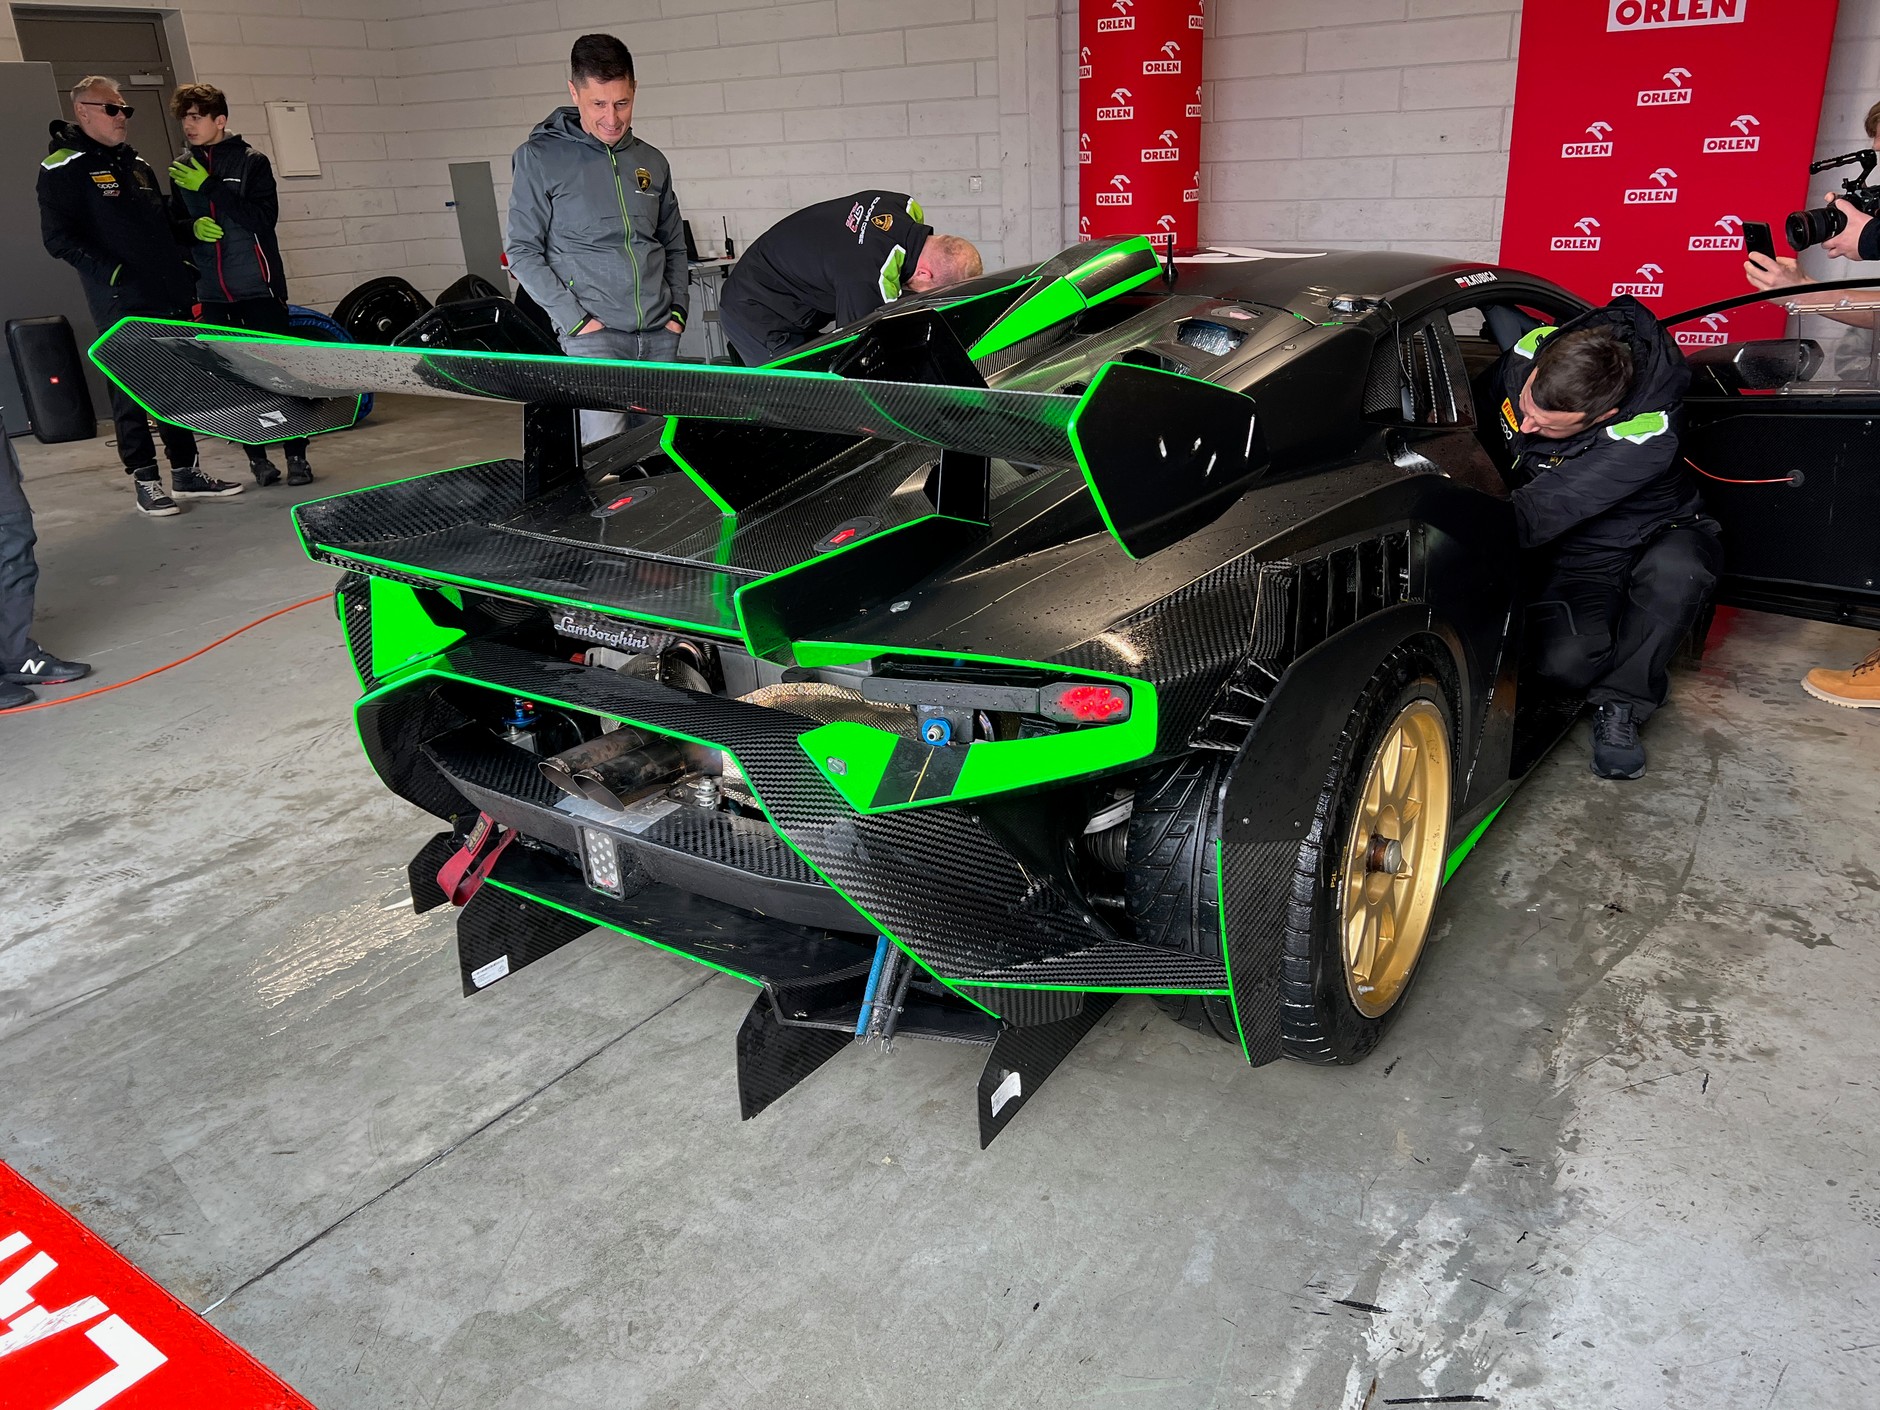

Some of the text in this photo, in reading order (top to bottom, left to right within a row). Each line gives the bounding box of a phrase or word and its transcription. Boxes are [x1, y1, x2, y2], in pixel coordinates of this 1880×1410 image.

[1615, 0, 1738, 26] ORLEN
[1099, 18, 1133, 31] ORLEN
[1145, 62, 1180, 73] ORLEN
[1640, 90, 1688, 104] ORLEN
[1098, 108, 1131, 119] ORLEN
[1564, 144, 1610, 156] ORLEN
[1706, 138, 1756, 151] ORLEN
[1143, 149, 1177, 161] ORLEN
[1097, 194, 1130, 204] ORLEN
[1627, 190, 1674, 202] ORLEN
[1553, 239, 1598, 249] ORLEN
[1691, 238, 1740, 249] ORLEN
[1614, 284, 1660, 296] ORLEN
[1677, 333, 1725, 345] ORLEN
[554, 616, 649, 648] Lamborghini
